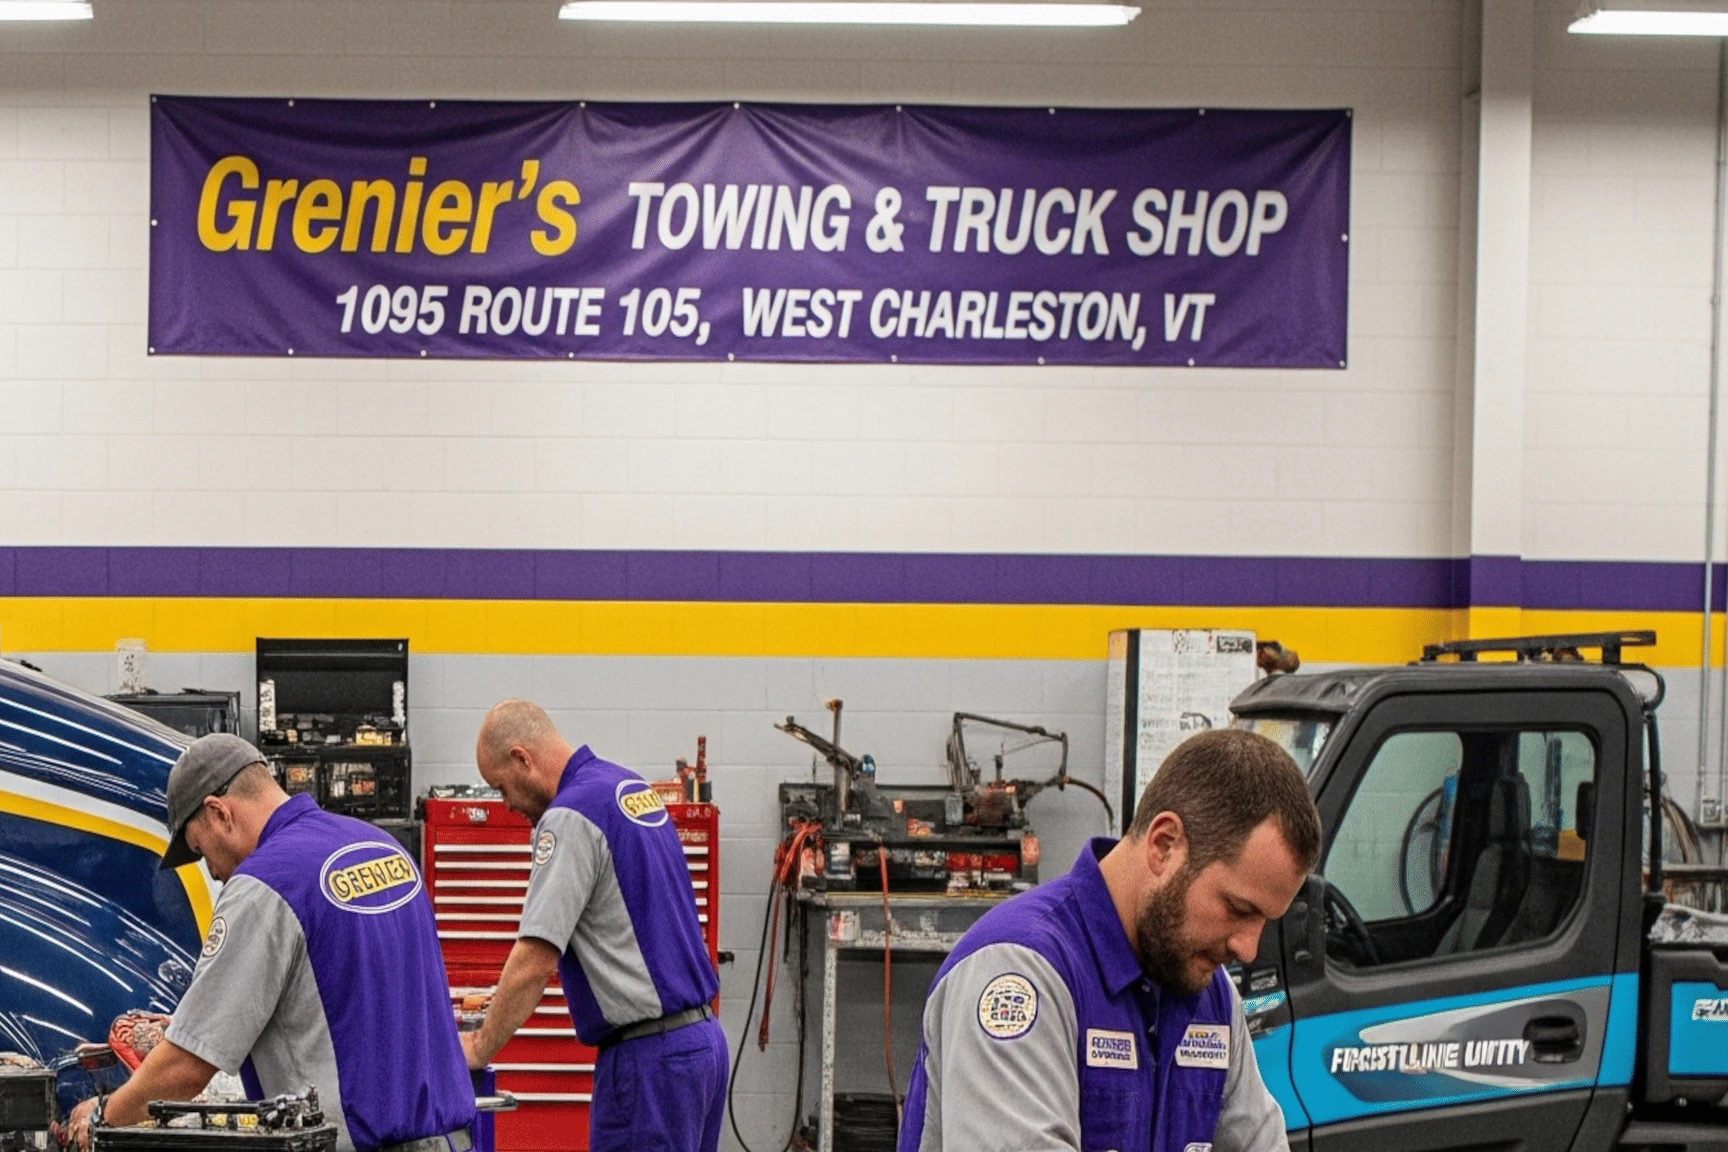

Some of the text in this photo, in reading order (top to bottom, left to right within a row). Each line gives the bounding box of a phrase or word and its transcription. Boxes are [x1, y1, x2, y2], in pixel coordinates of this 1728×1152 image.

[196, 154, 1289, 258] Grenier's TOWING & TRUCK SHOP
[335, 284, 1216, 351] 1095 ROUTE 105, WEST CHARLESTON, VT
